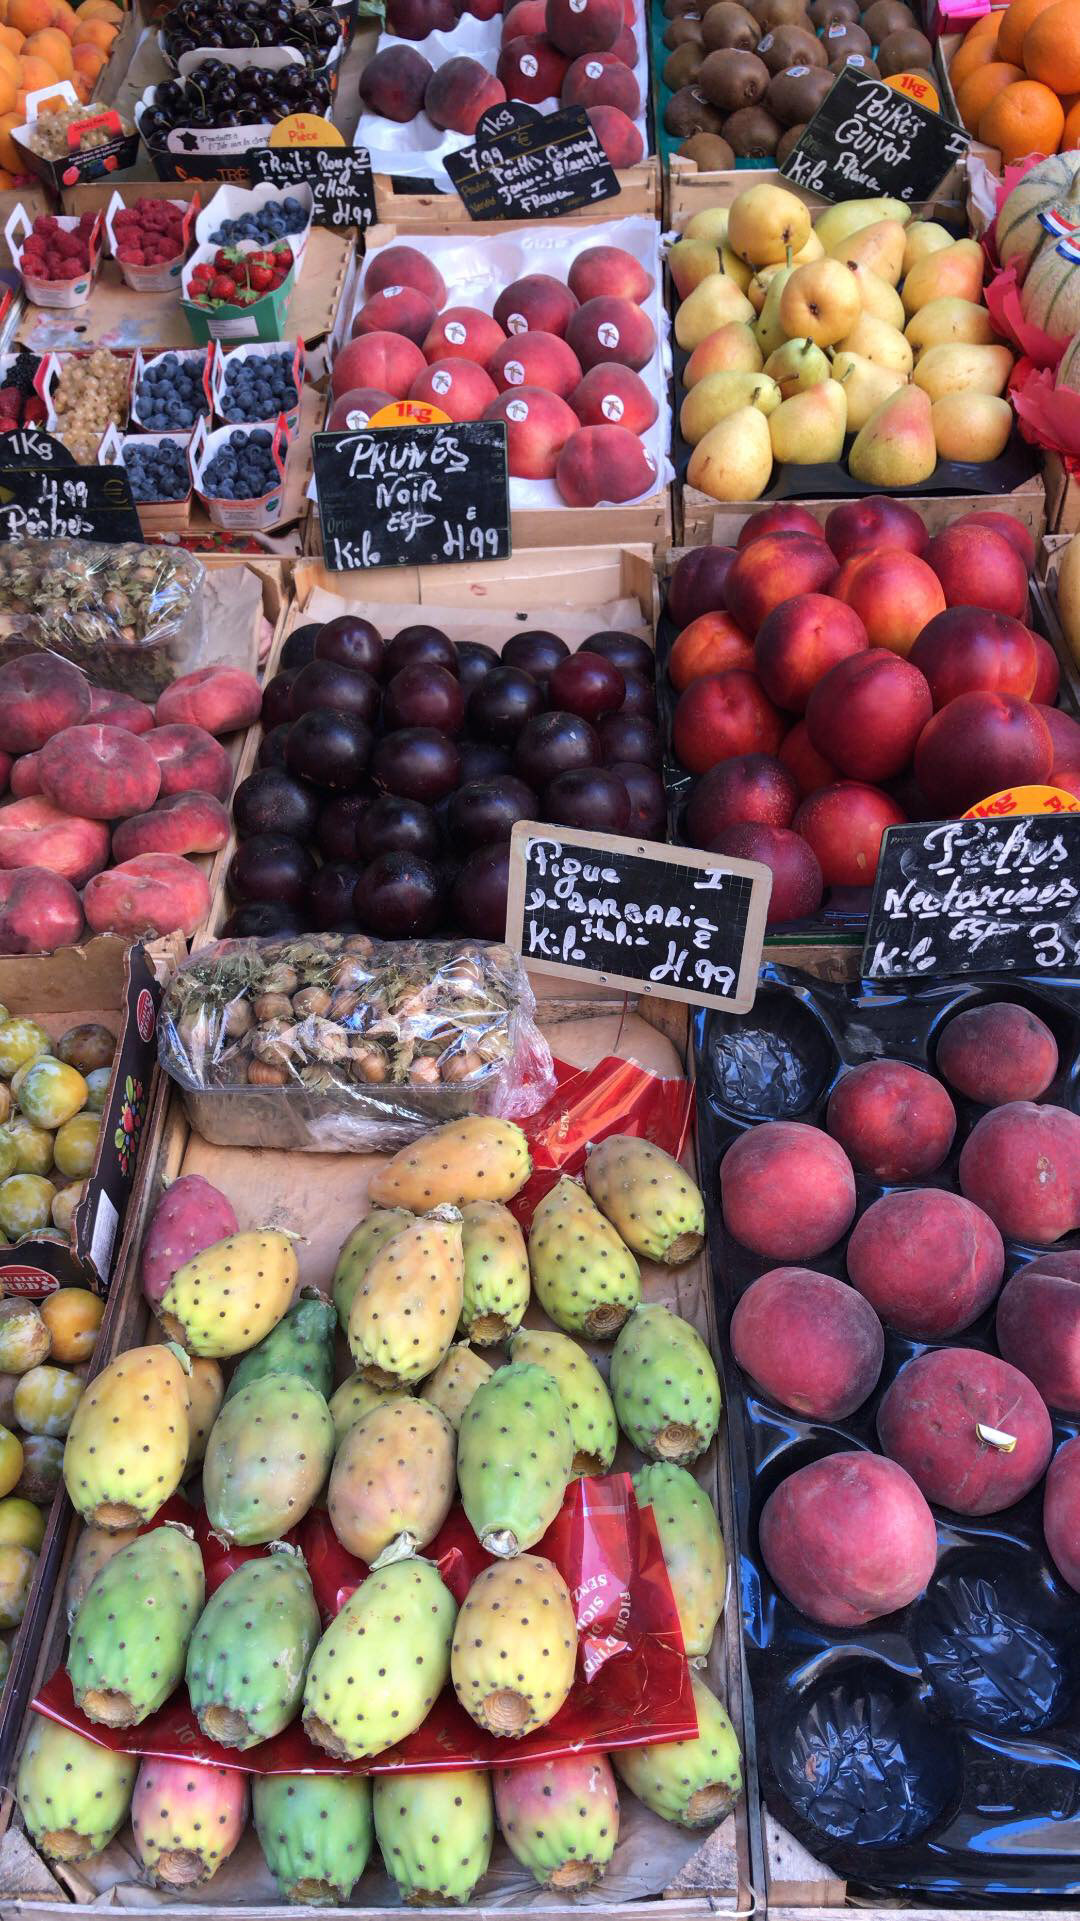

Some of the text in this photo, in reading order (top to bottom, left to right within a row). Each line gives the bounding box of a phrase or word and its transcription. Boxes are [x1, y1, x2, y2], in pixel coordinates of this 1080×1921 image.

[900, 76, 928, 97] 1kg
[482, 110, 515, 136] 1kg
[460, 147, 504, 175] 7.99
[332, 199, 372, 225] 4.99
[396, 403, 432, 423] 1kg
[333, 521, 499, 571] Kilo 4.99
[650, 940, 735, 996] 4.99
[571, 1573, 608, 1602] SENZ
